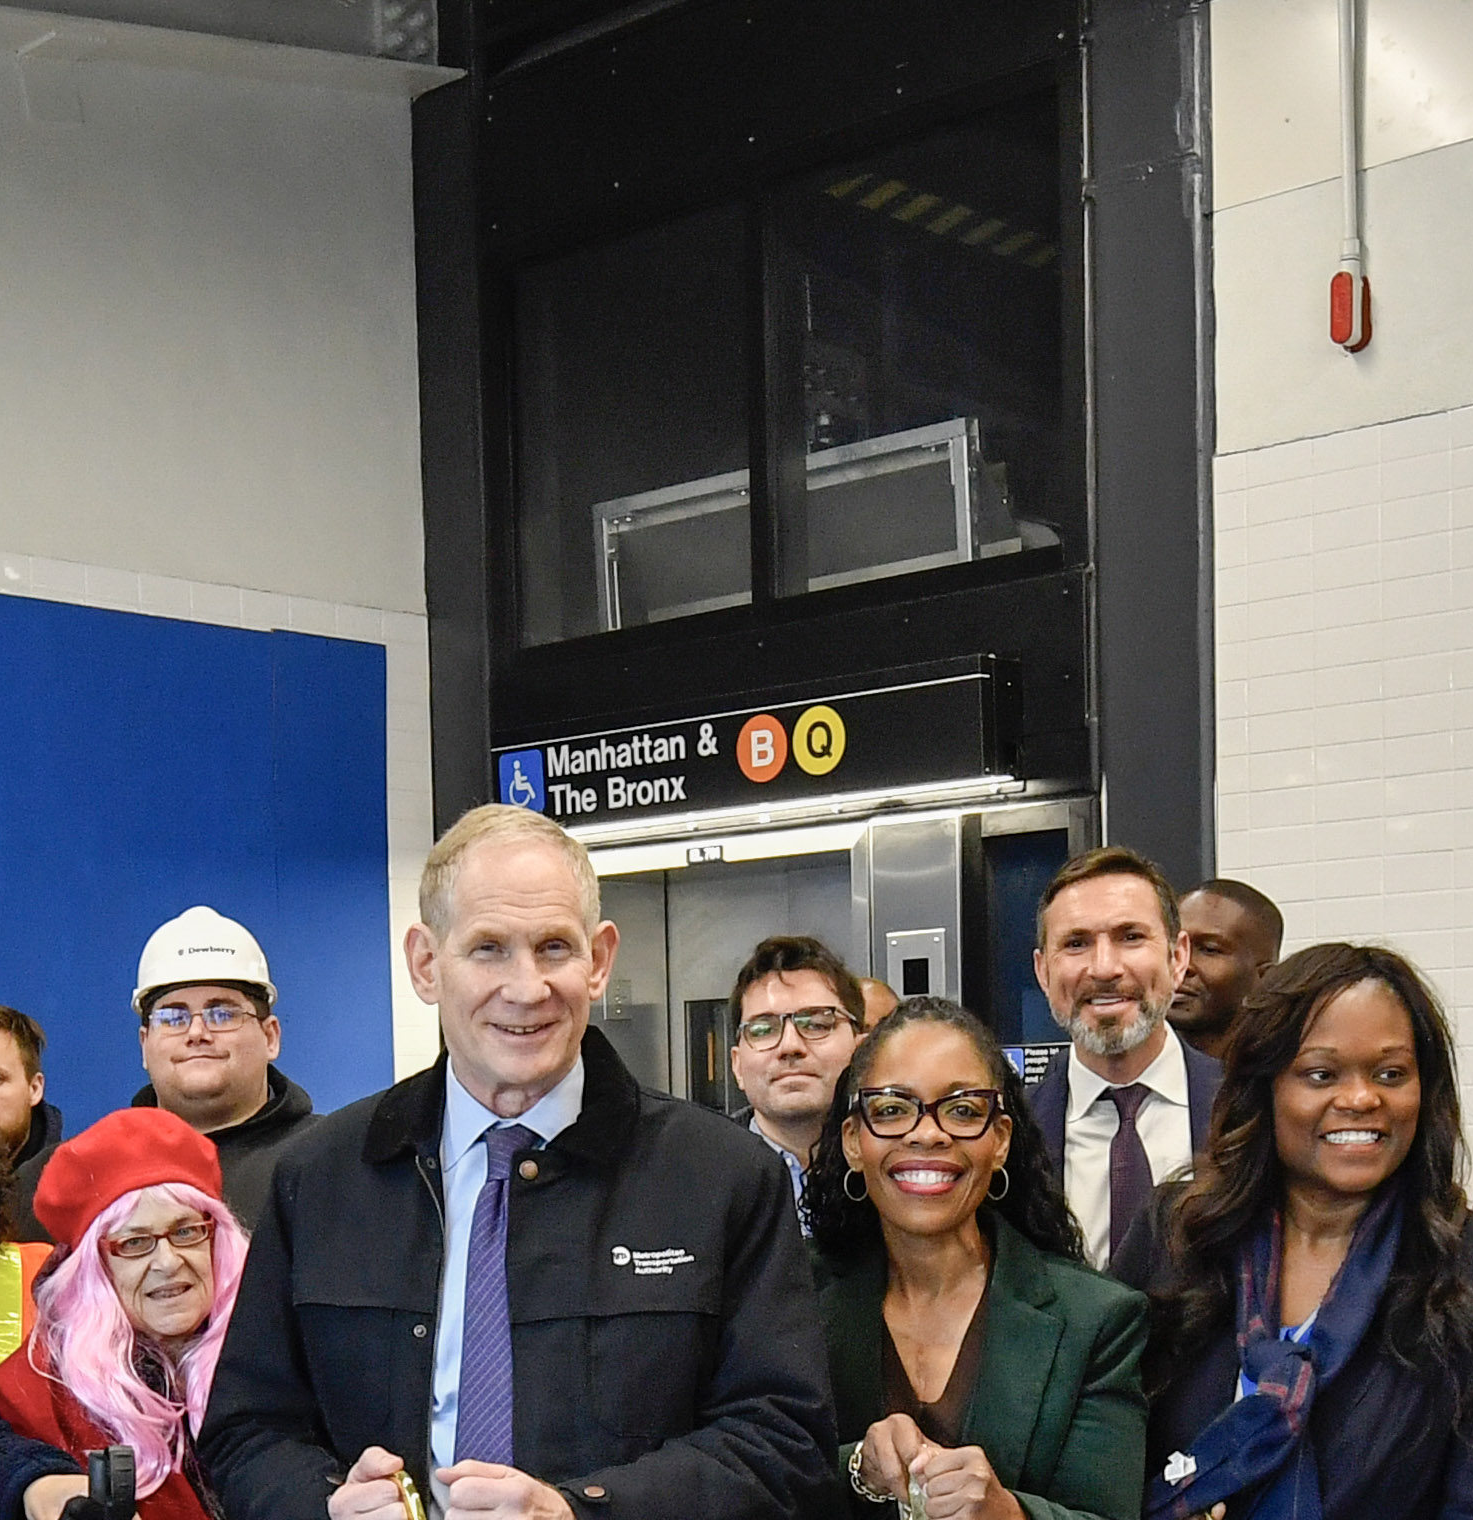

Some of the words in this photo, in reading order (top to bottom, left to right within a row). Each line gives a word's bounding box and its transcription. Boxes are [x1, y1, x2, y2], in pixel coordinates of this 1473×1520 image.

[546, 734, 687, 778] Manhattan
[696, 723, 719, 757] &
[751, 729, 775, 768] B
[806, 721, 833, 759] Q
[548, 783, 597, 816] The
[607, 776, 688, 810] Bronx
[188, 946, 236, 955] Dewberry
[634, 1266, 674, 1275] Authority
